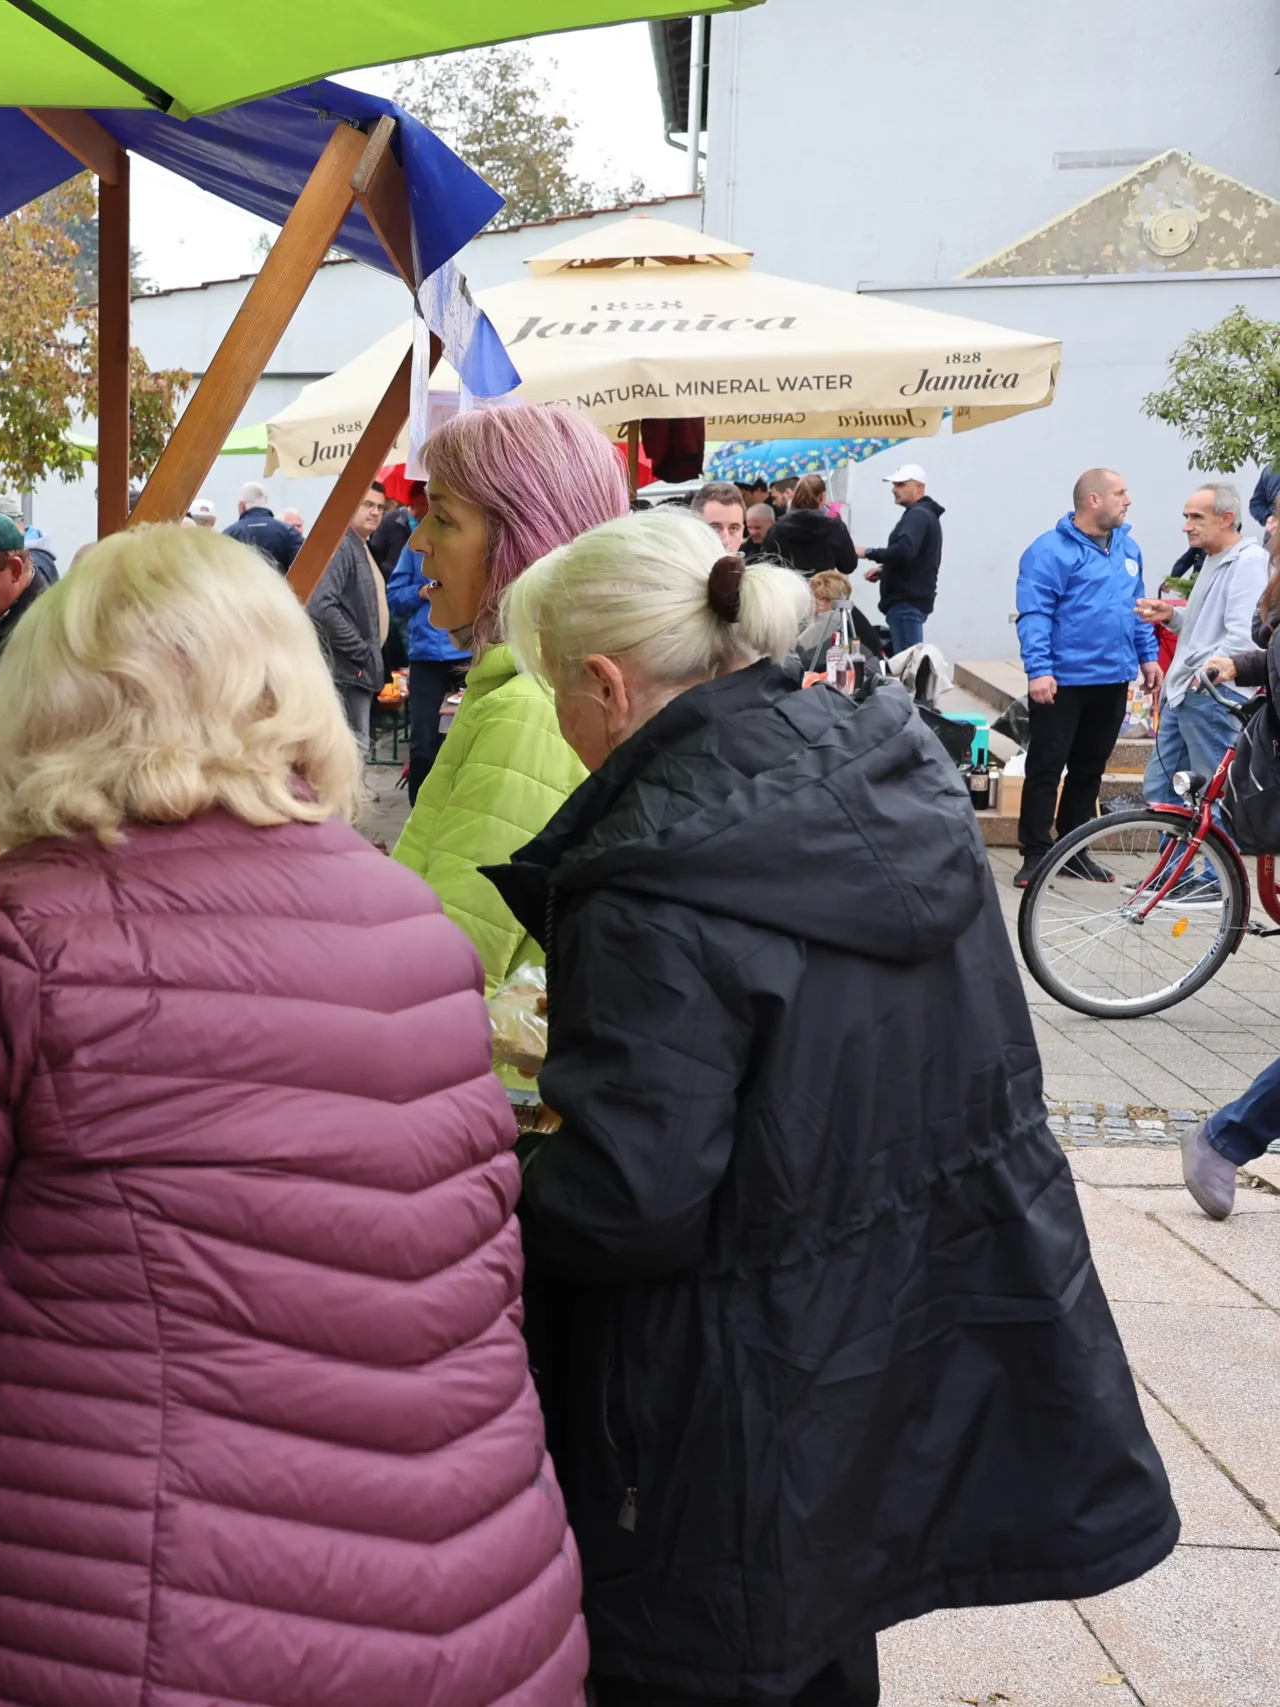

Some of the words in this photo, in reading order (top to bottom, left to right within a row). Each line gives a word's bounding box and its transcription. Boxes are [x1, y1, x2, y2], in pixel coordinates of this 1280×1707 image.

[589, 300, 684, 312] 1828
[504, 313, 802, 348] Jamnica
[944, 351, 982, 365] 1828
[577, 382, 670, 410] NATURAL
[675, 377, 771, 397] MINERAL
[776, 373, 853, 392] WATER
[899, 368, 1021, 397] Jamnica
[331, 420, 363, 435] 1828
